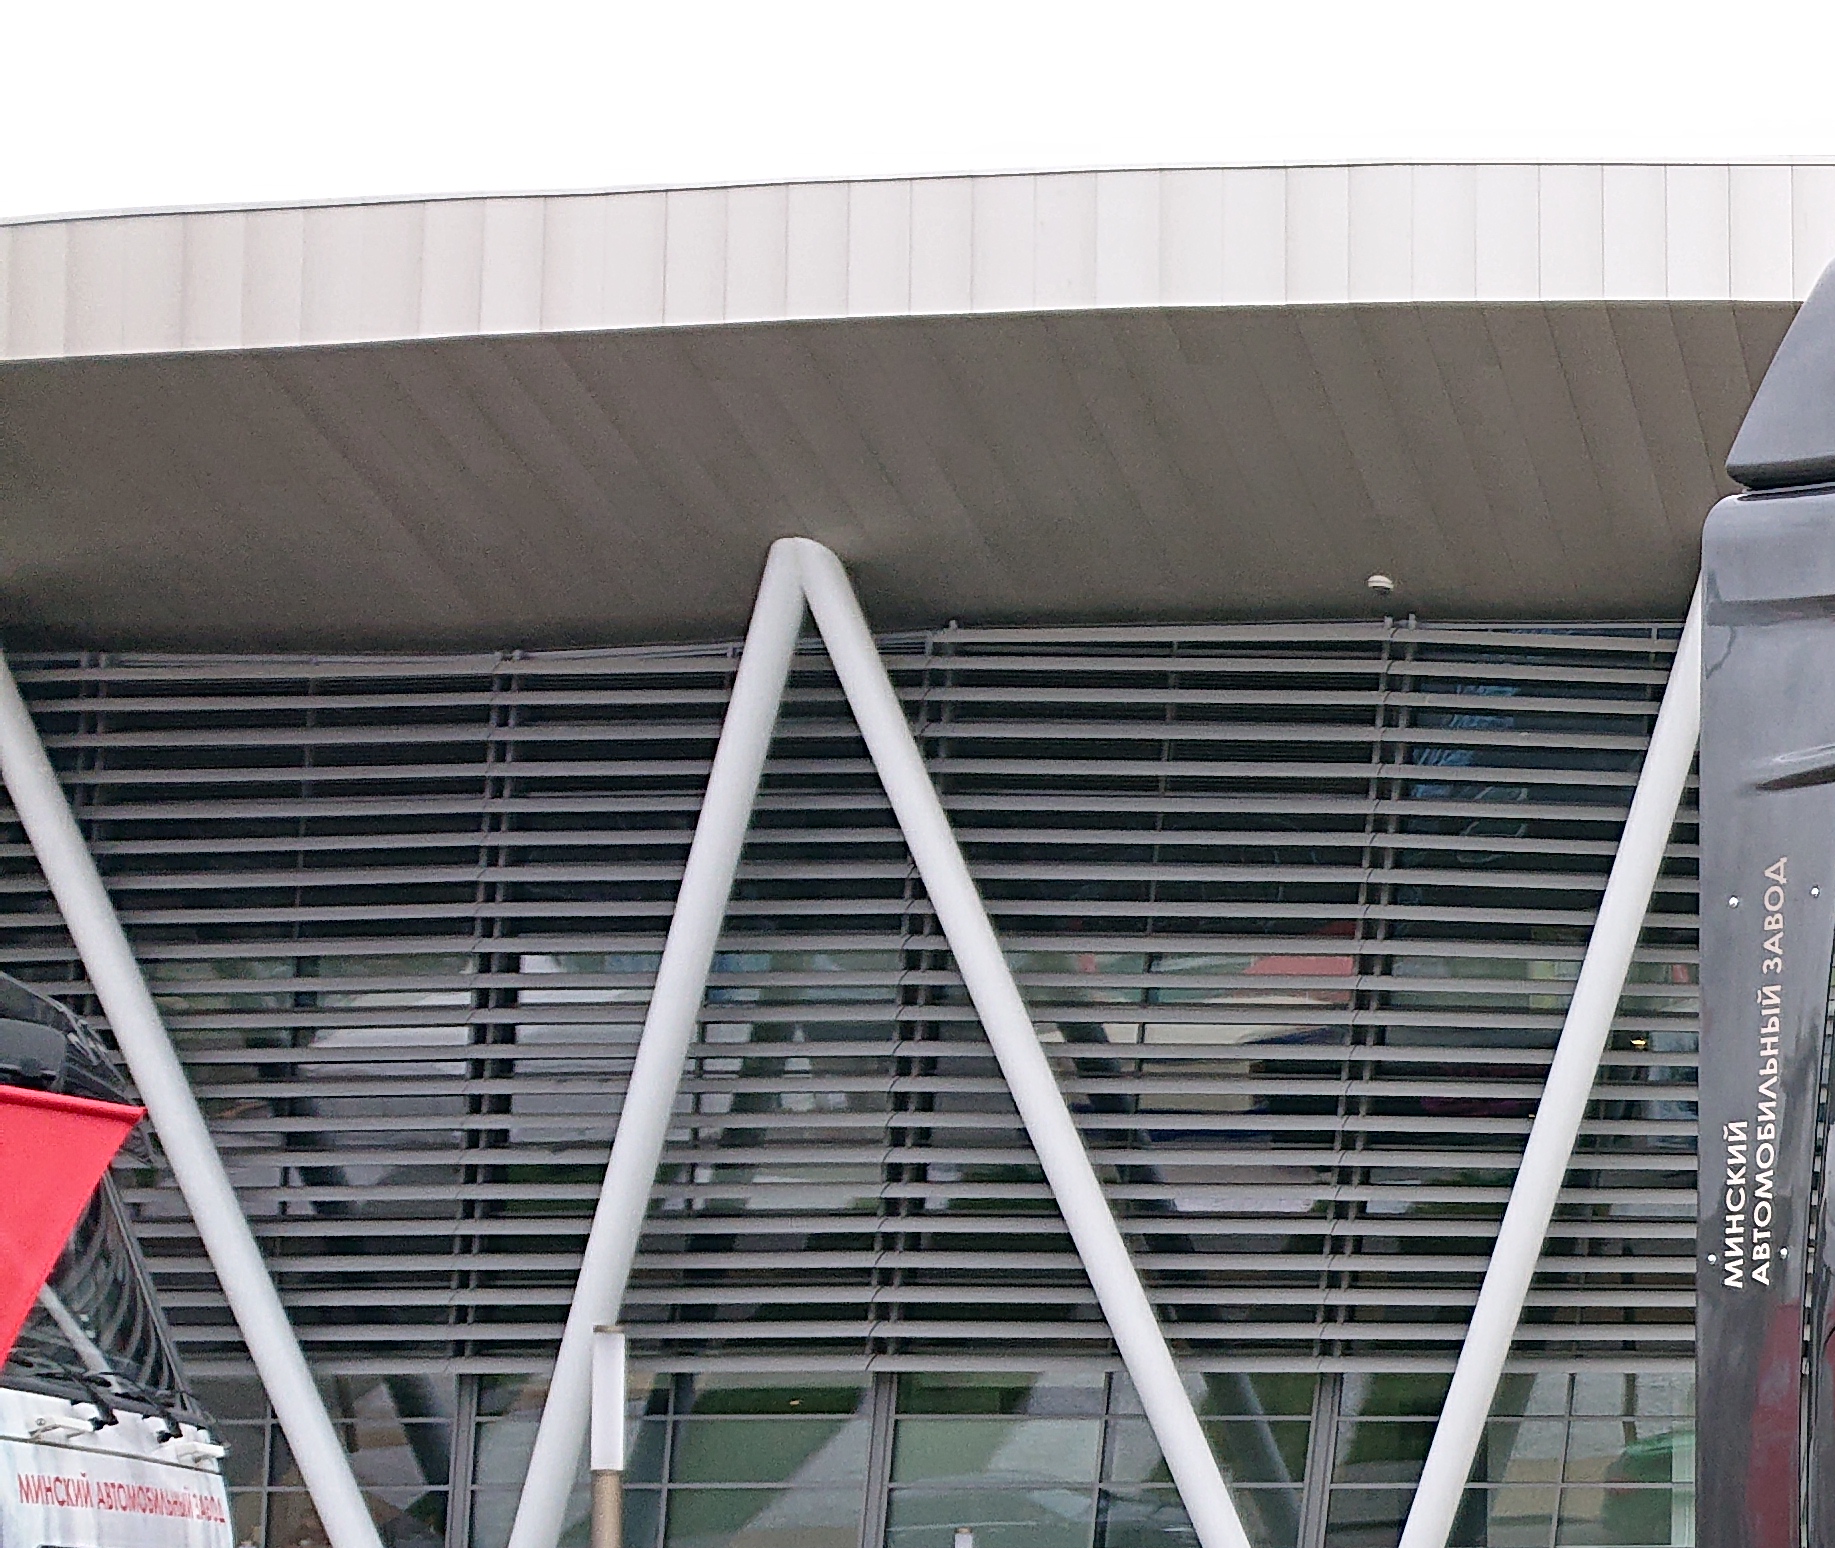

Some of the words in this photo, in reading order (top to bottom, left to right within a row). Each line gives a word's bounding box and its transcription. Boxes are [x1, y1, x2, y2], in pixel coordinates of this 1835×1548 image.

[1761, 857, 1788, 974] ЗАВОД
[1723, 1121, 1748, 1289] МИНСКИЙ
[1750, 984, 1782, 1286] АВТОМОБИЛЬНЫЙ
[17, 1472, 93, 1509] МИНСКИЙ
